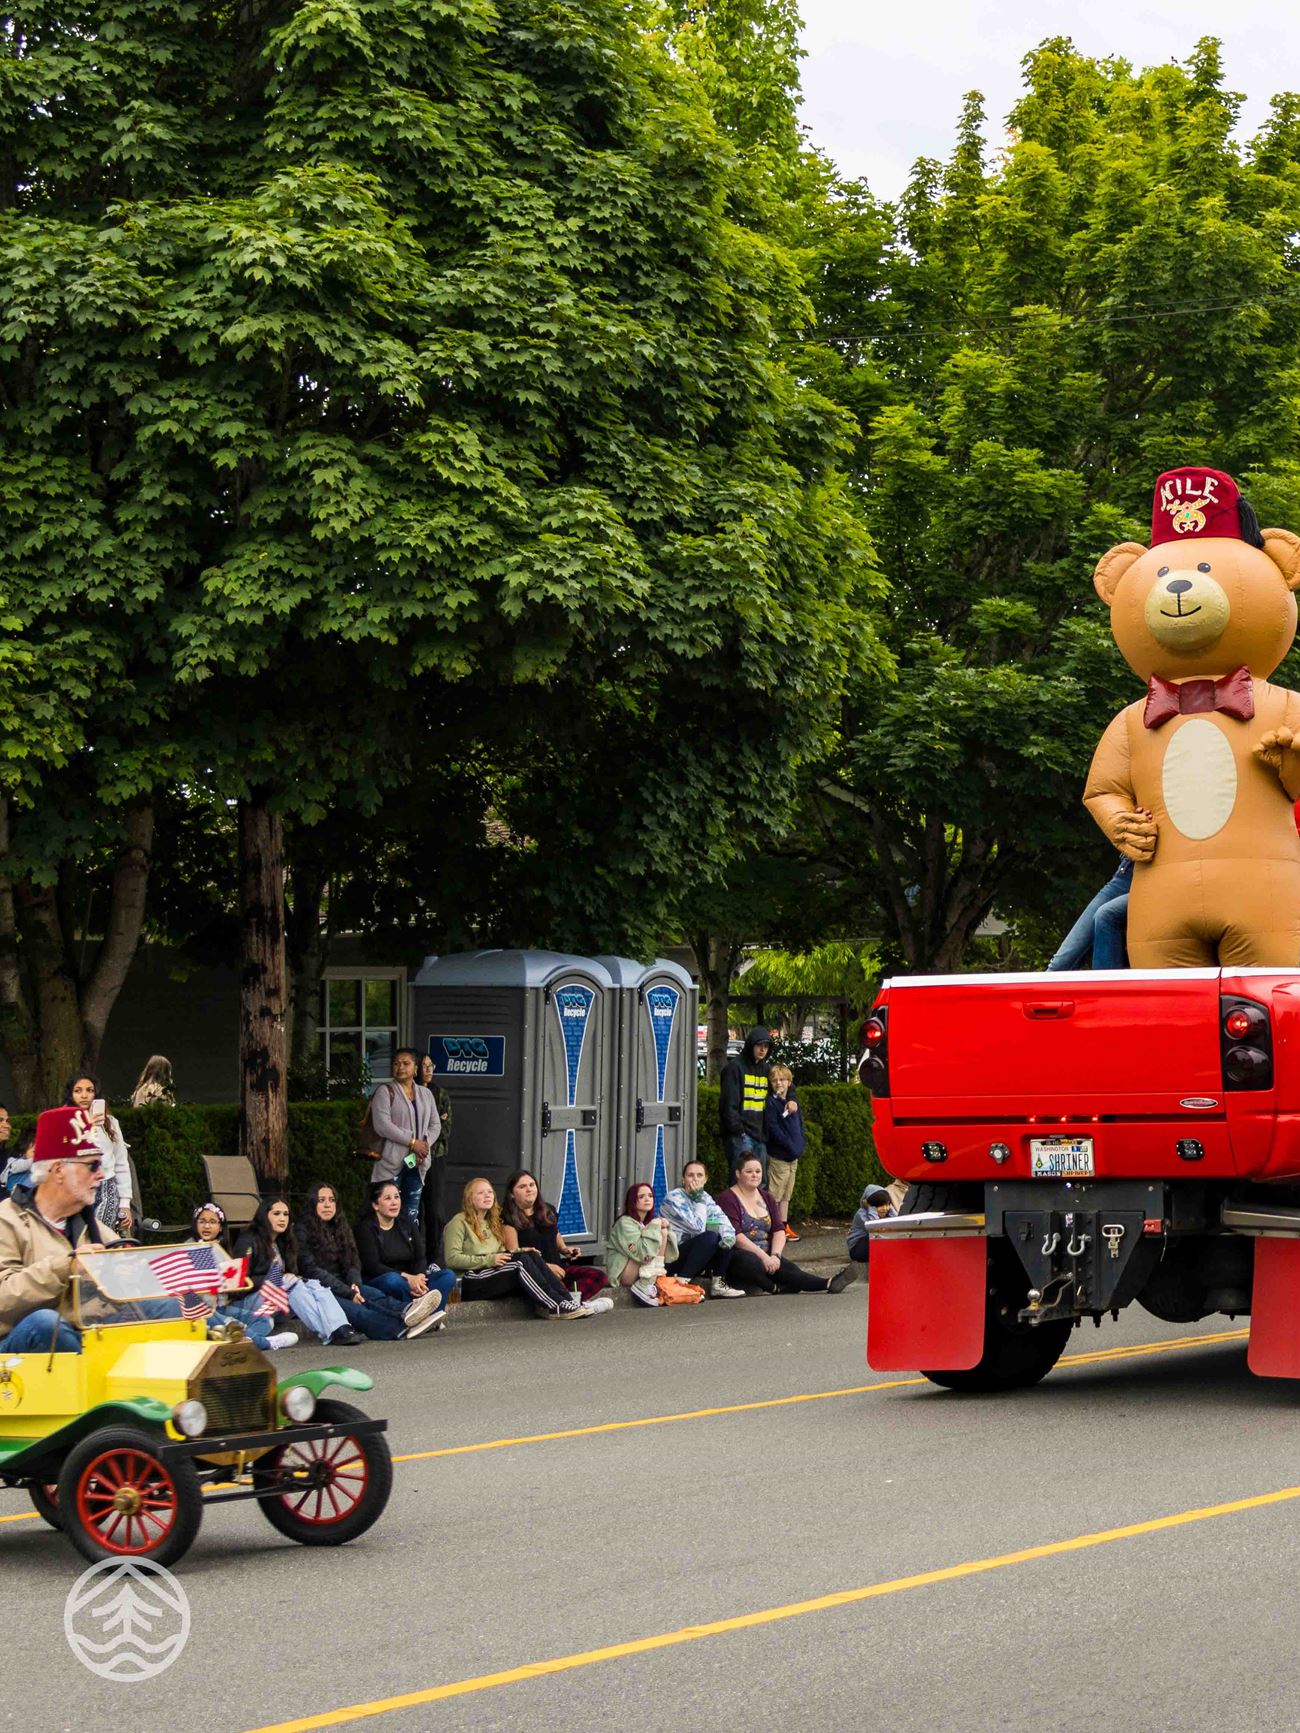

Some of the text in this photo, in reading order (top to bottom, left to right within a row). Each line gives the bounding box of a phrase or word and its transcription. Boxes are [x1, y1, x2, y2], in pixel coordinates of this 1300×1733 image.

[1160, 476, 1219, 512] NILE
[563, 1007, 586, 1018] Recycle
[654, 1007, 673, 1018] Recycle
[442, 1037, 490, 1059] DTG
[446, 1058, 489, 1073] Recycle
[1049, 1154, 1089, 1171] SHRINER
